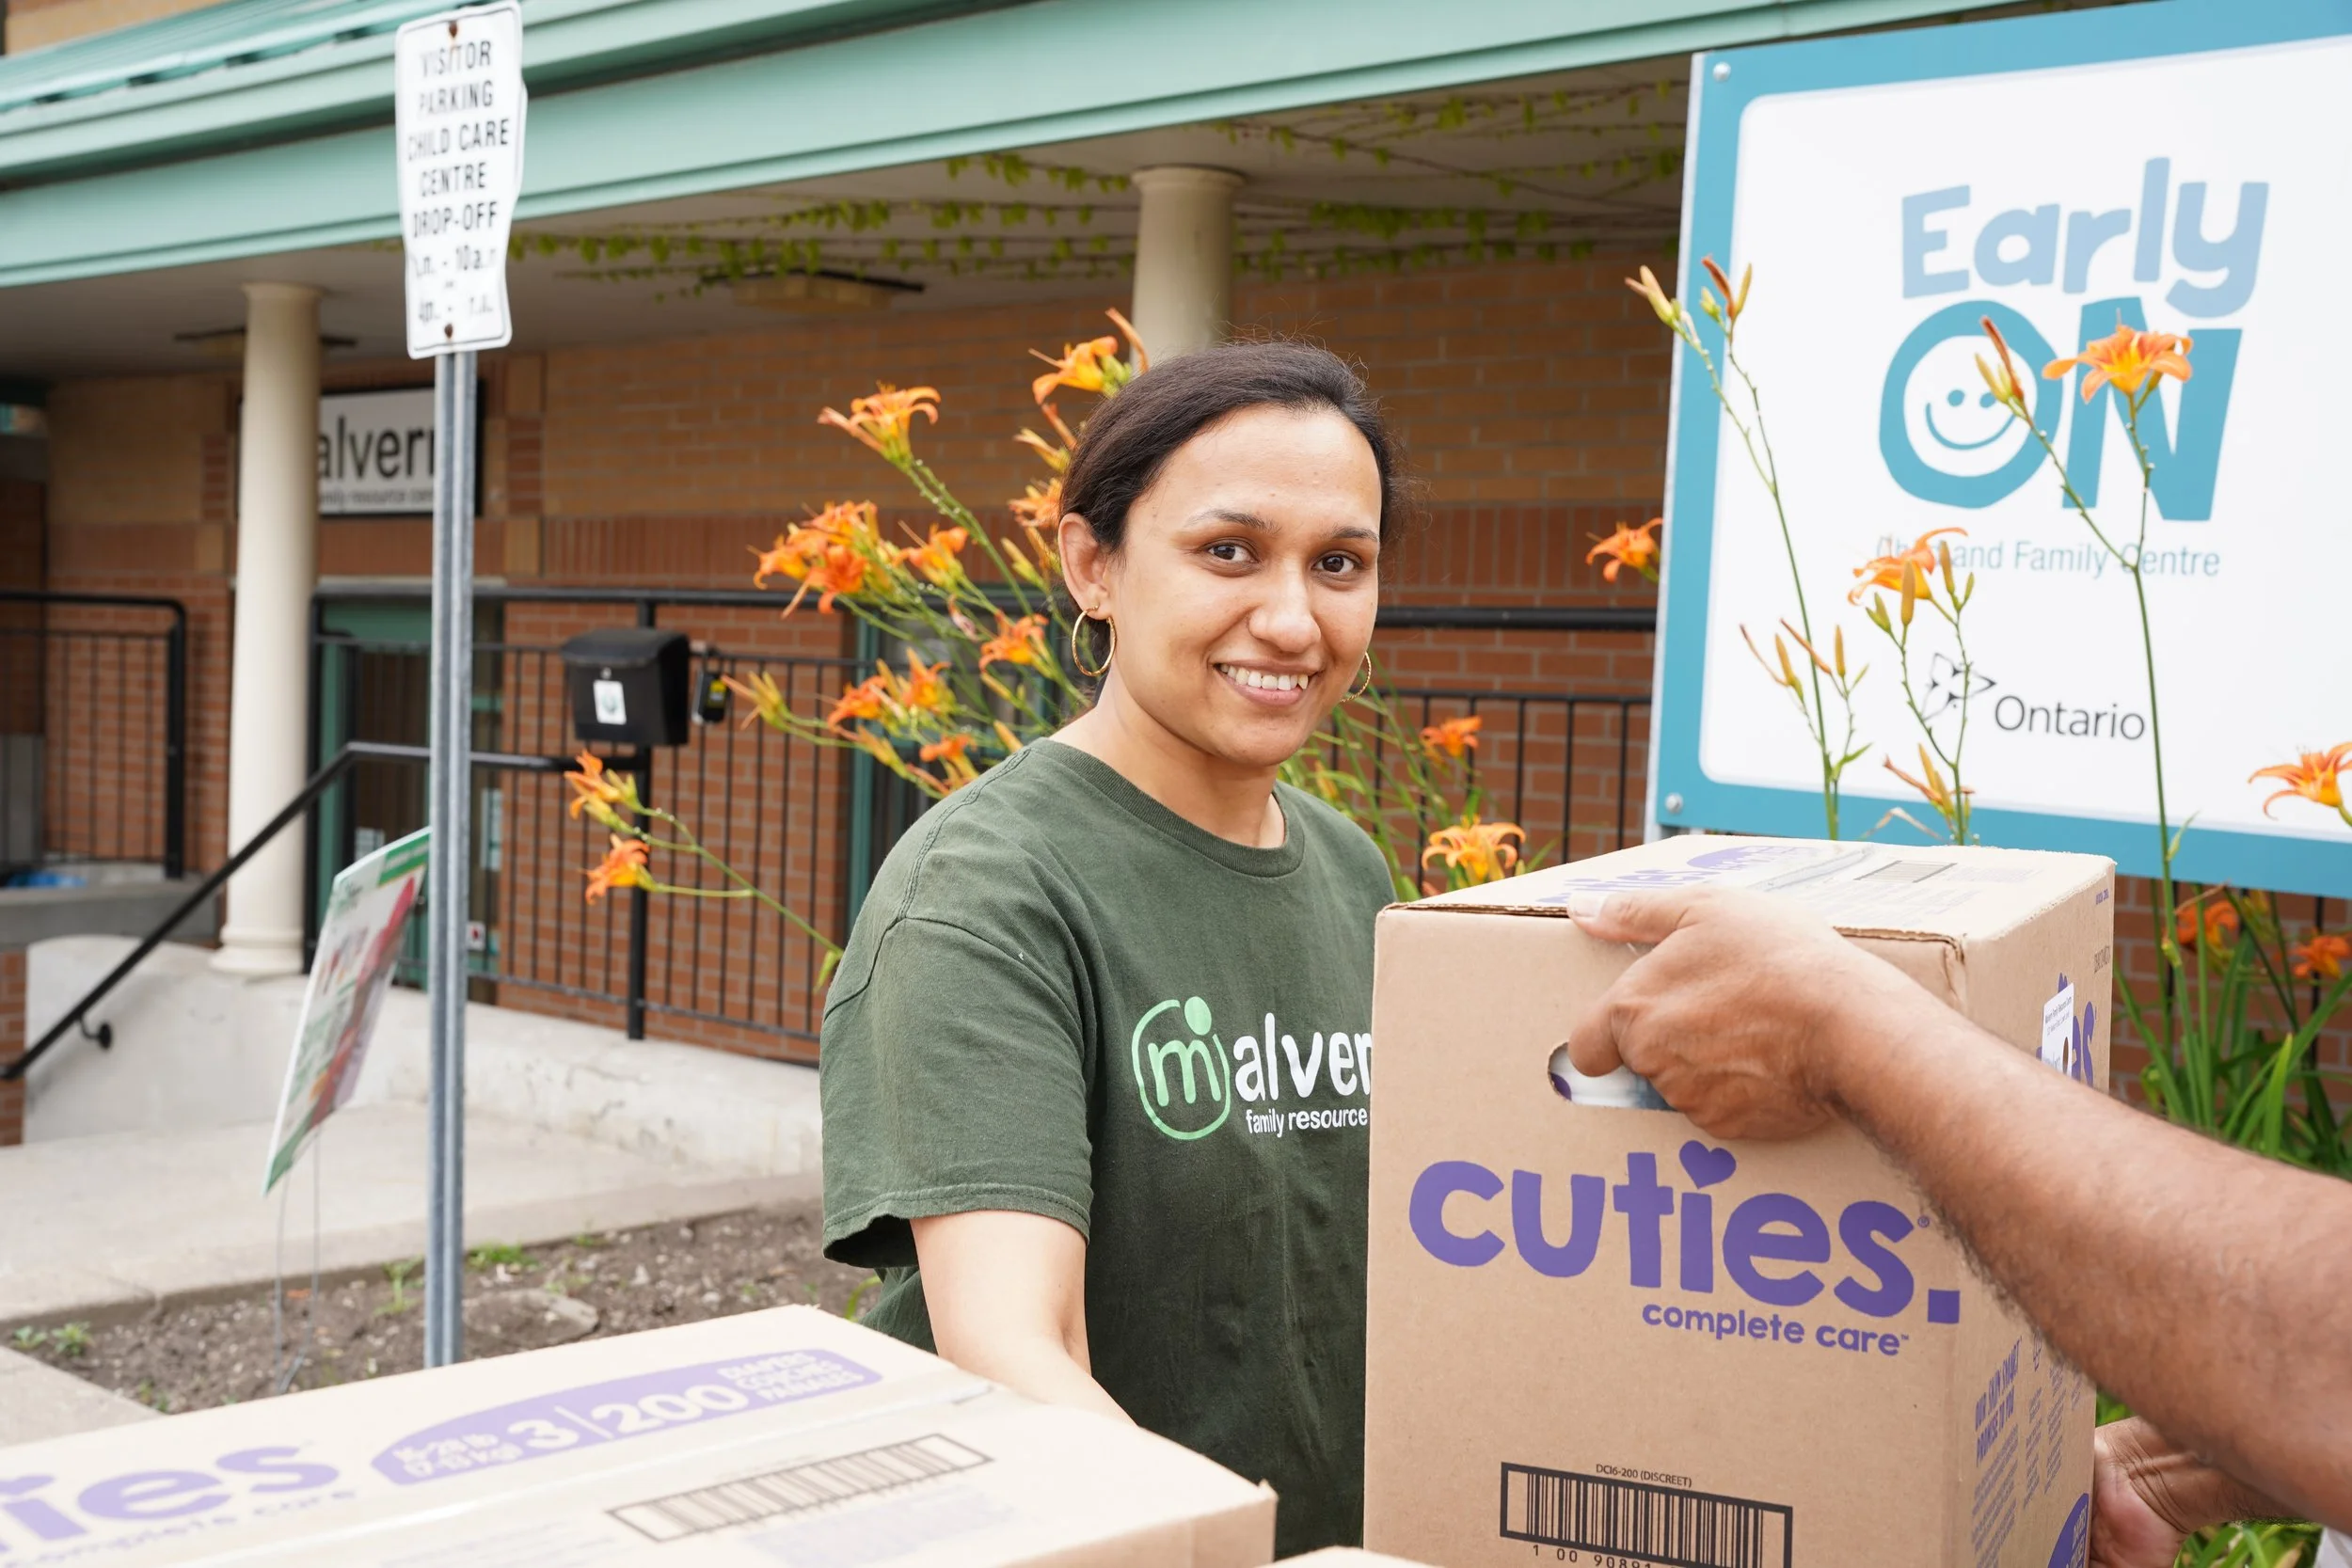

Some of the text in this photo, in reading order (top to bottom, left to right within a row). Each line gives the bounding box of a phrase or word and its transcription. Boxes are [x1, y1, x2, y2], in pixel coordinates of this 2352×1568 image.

[421, 40, 492, 77] VISITOR
[419, 80, 493, 114] PARKING
[407, 119, 510, 161] CHILD CARE
[421, 162, 486, 198] CENTRE
[413, 201, 498, 238] DROP-OFF
[1901, 158, 2268, 318] Early
[1880, 297, 2241, 520] ON
[319, 412, 434, 479] alver
[1952, 541, 2002, 570] and
[2014, 541, 2109, 578] Family
[2122, 543, 2220, 576] Centre
[1996, 697, 2144, 737] Ontario
[1246, 1107, 1368, 1137] family resource
[1642, 1303, 1804, 1343] complete
[507, 1384, 750, 1449] 3 200
[0, 1446, 340, 1549] ies
[1640, 1470, 1692, 1488] (DISCREET)
